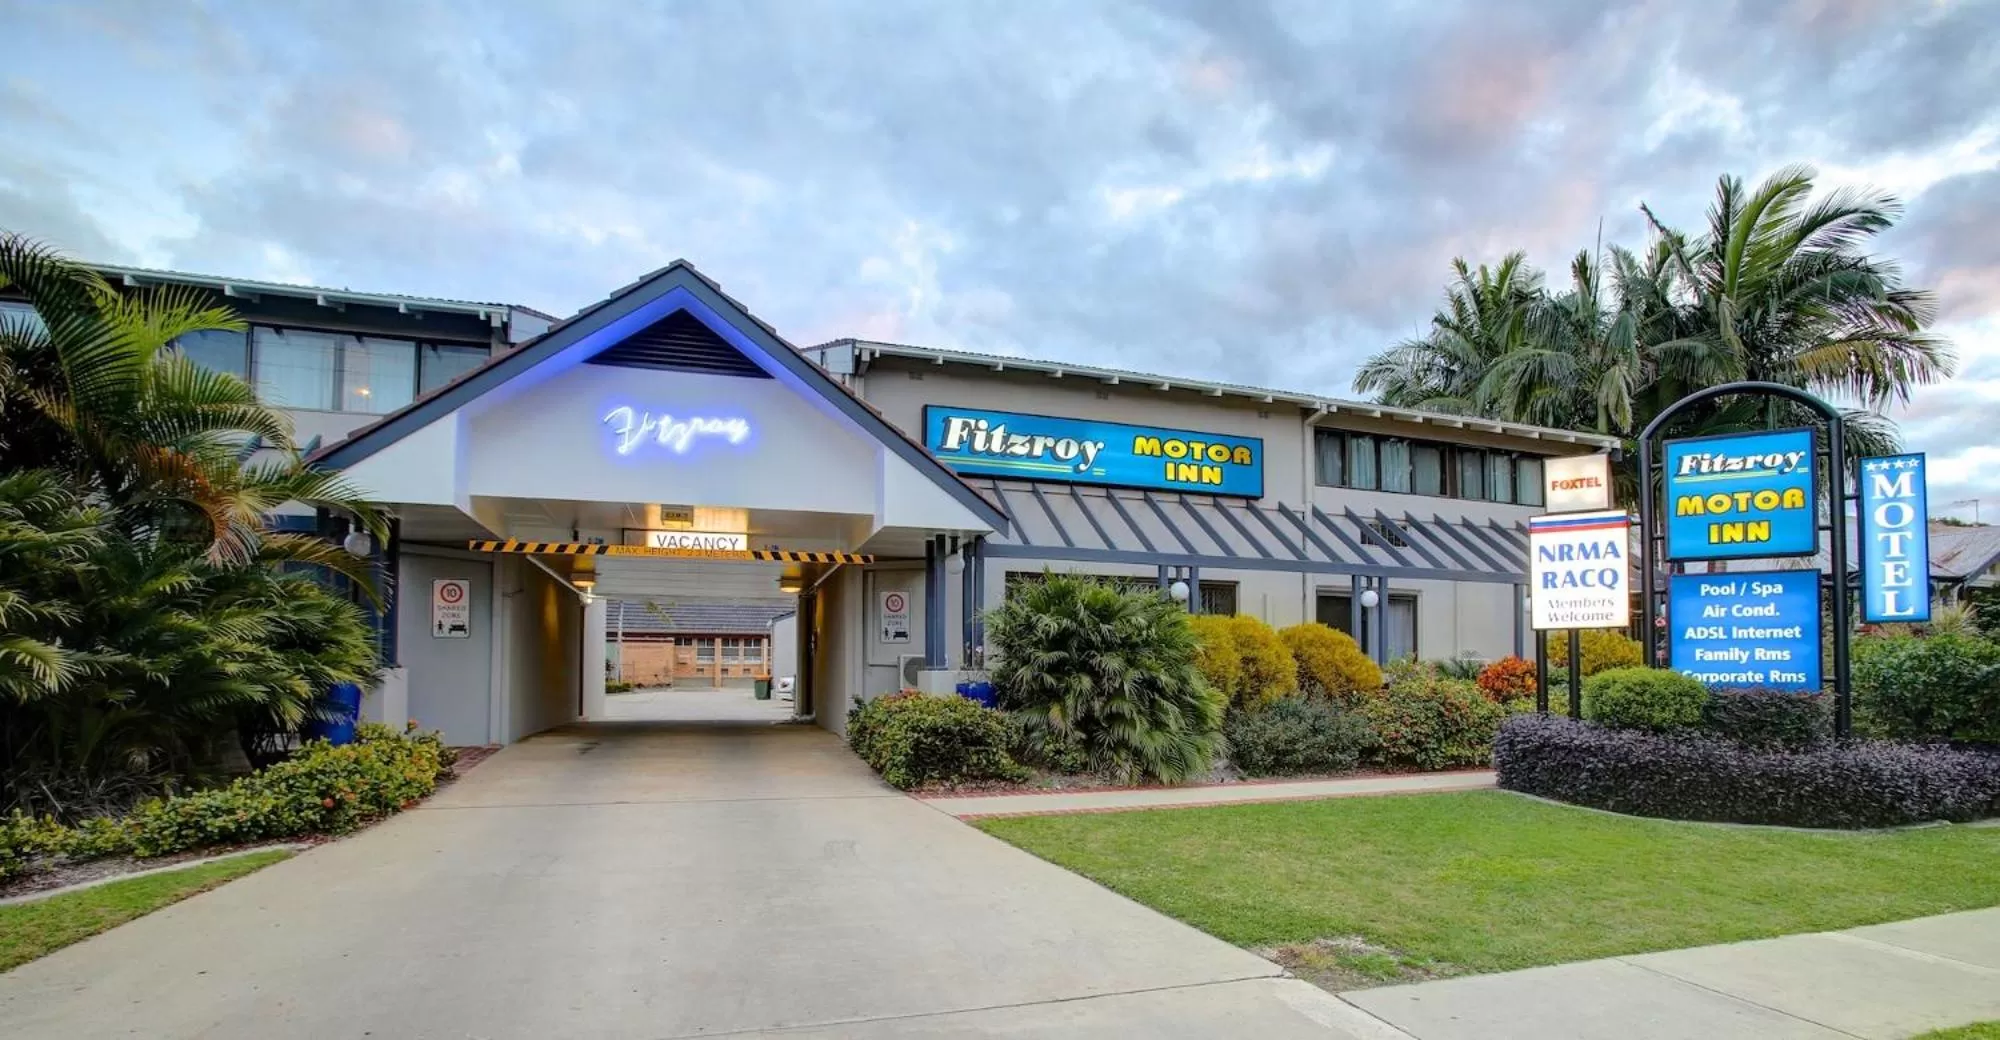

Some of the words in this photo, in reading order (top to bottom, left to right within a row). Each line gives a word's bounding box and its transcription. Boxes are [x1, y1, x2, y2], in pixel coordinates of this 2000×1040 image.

[942, 415, 1105, 471] Fitzroy
[1132, 435, 1253, 466] MOTOR
[1164, 461, 1224, 486] INN
[1677, 450, 1806, 477] Fitzroy
[1551, 477, 1602, 492] FOXTEL
[1676, 486, 1806, 518] MOTOR
[656, 534, 739, 552] VACANCY
[1708, 520, 1771, 545] INN
[1869, 471, 1917, 617] MOTEL
[1538, 540, 1621, 563] NRMA
[1542, 568, 1620, 591] RACQ
[1700, 582, 1736, 596] Pool
[1740, 582, 1747, 596] /
[1751, 582, 1784, 598] Spa
[1548, 611, 1614, 623] Welcome
[1702, 604, 1727, 618] Air
[1731, 602, 1780, 617] Cond.
[1684, 627, 1727, 639] ADSL
[1732, 625, 1802, 639] Internet
[1695, 647, 1749, 664] Family
[1754, 648, 1791, 661] Rms
[1770, 670, 1806, 683] Rms
